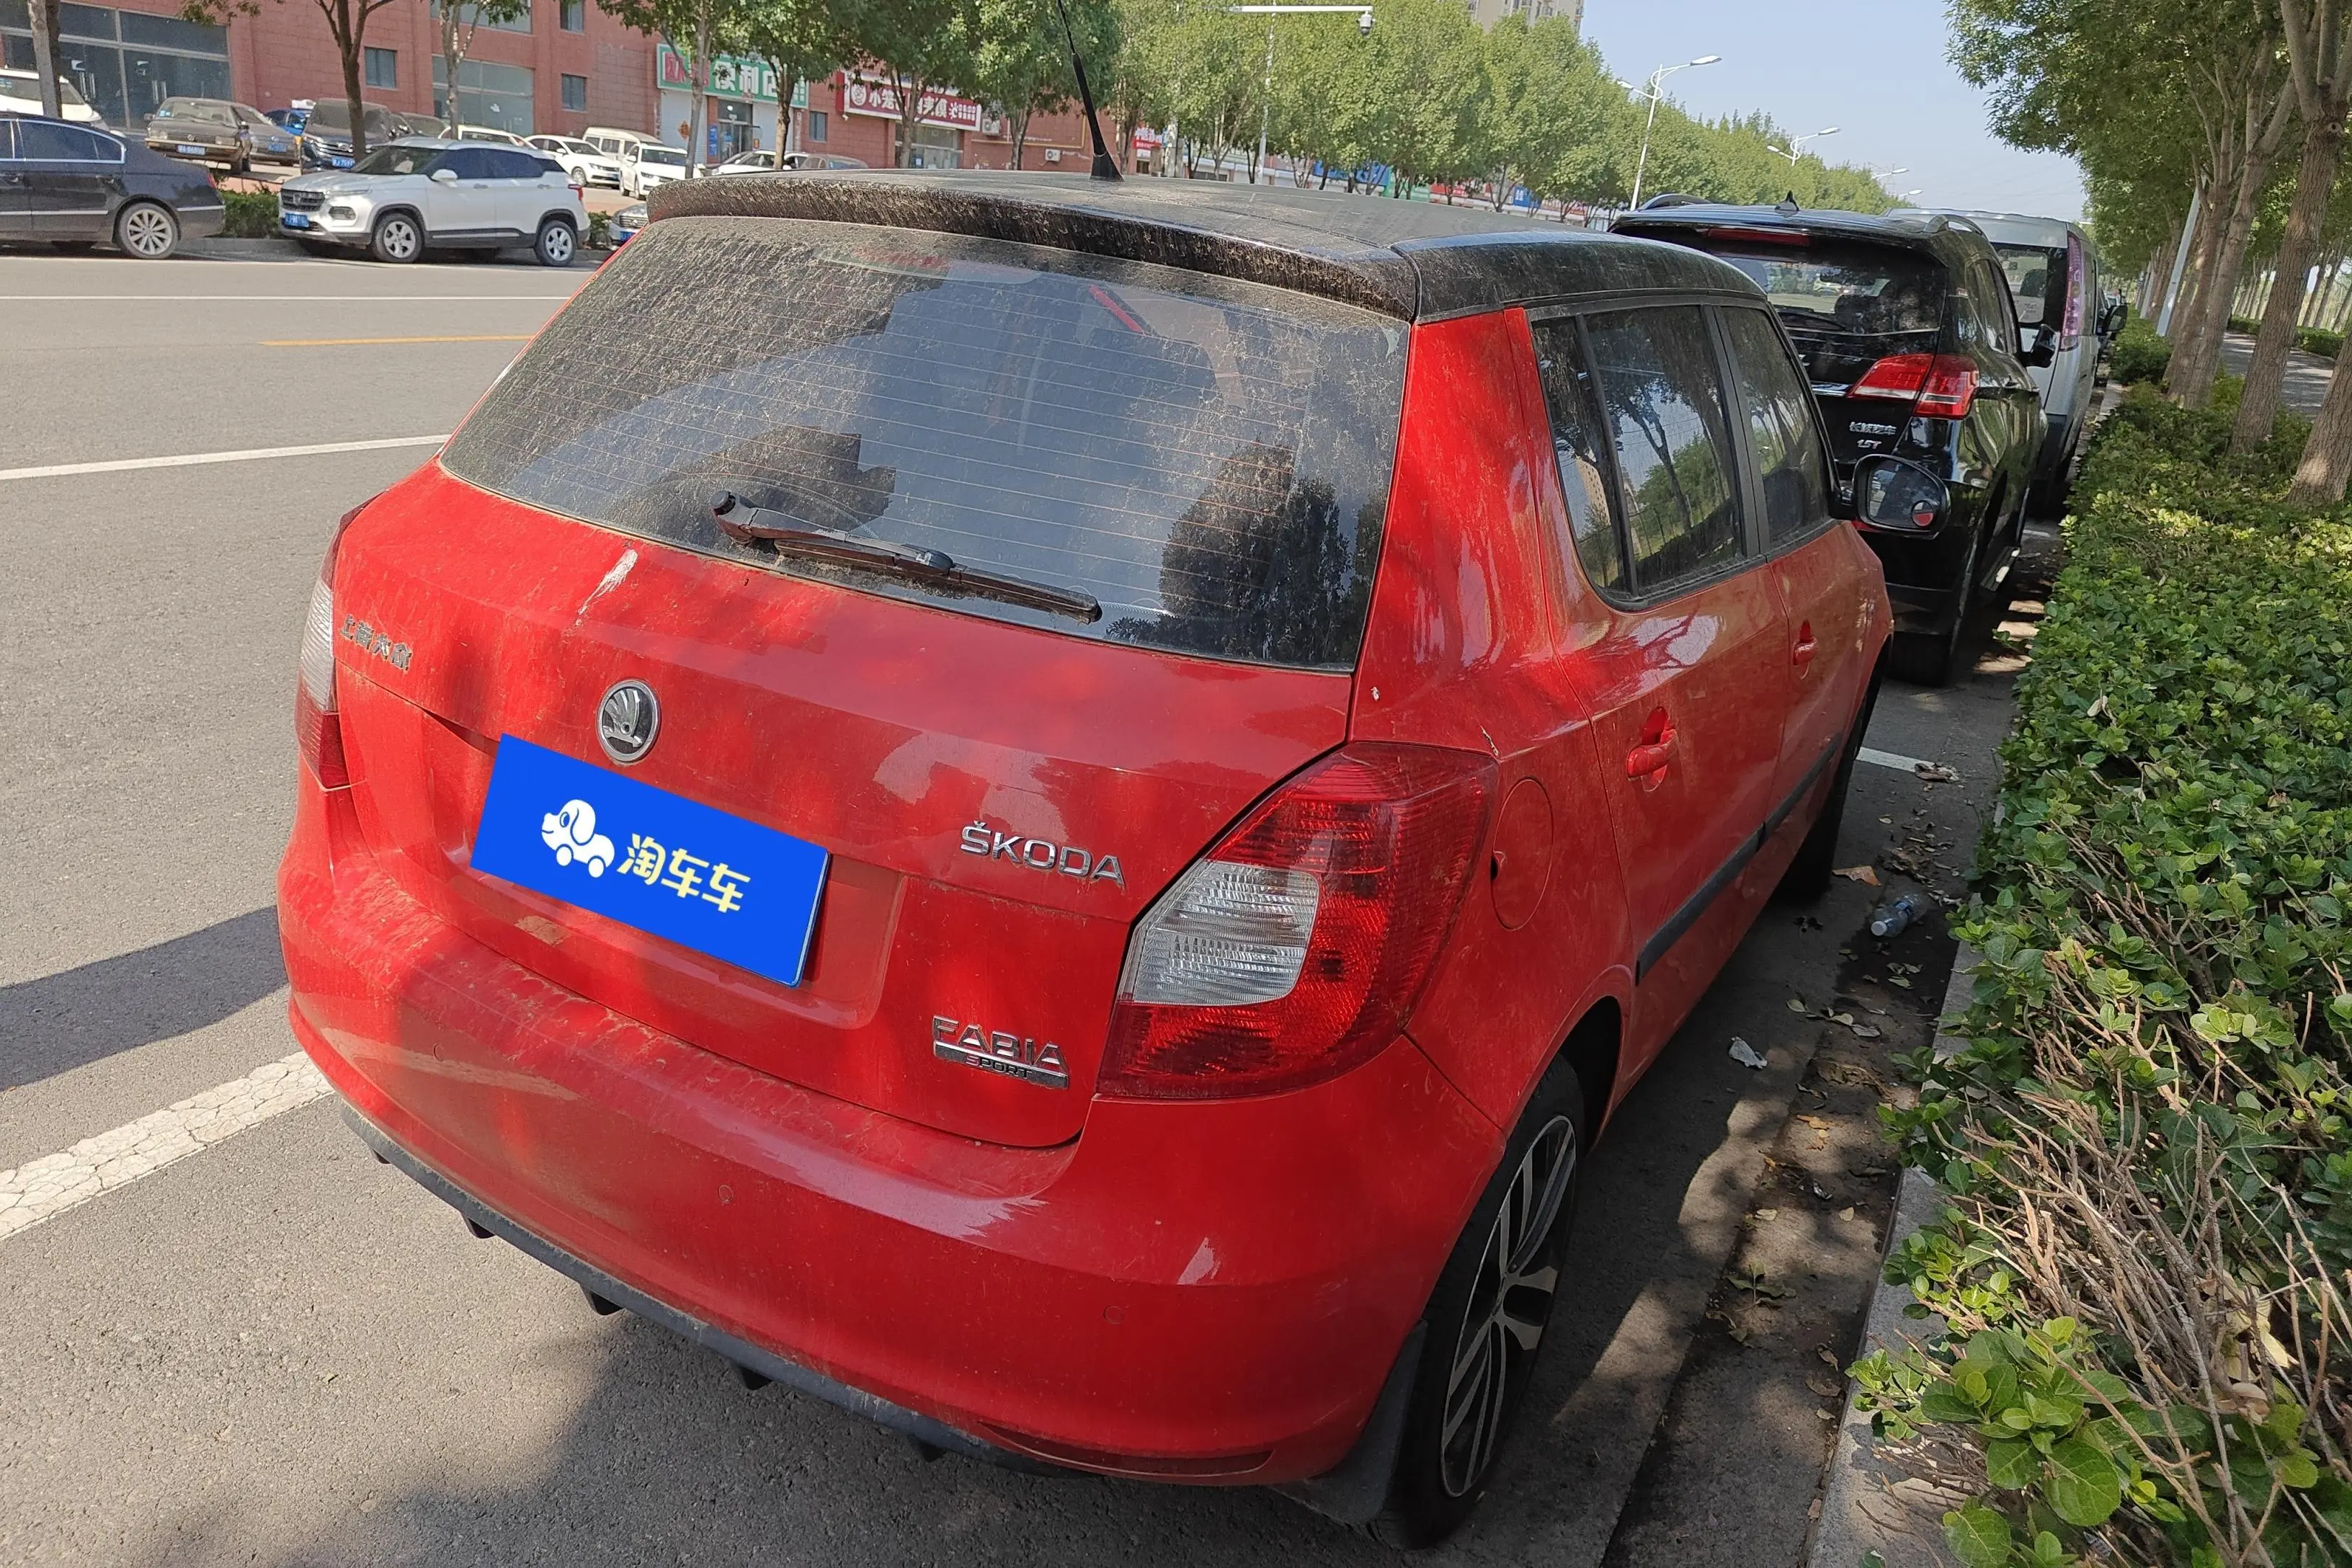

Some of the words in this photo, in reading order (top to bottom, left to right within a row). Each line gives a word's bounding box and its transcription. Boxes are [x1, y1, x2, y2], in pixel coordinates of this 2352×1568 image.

[341, 615, 411, 671] 上海大众
[961, 820, 1126, 887] ŠKODA
[932, 1015, 1070, 1074] FABIA
[966, 1054, 1032, 1079] SPORT
